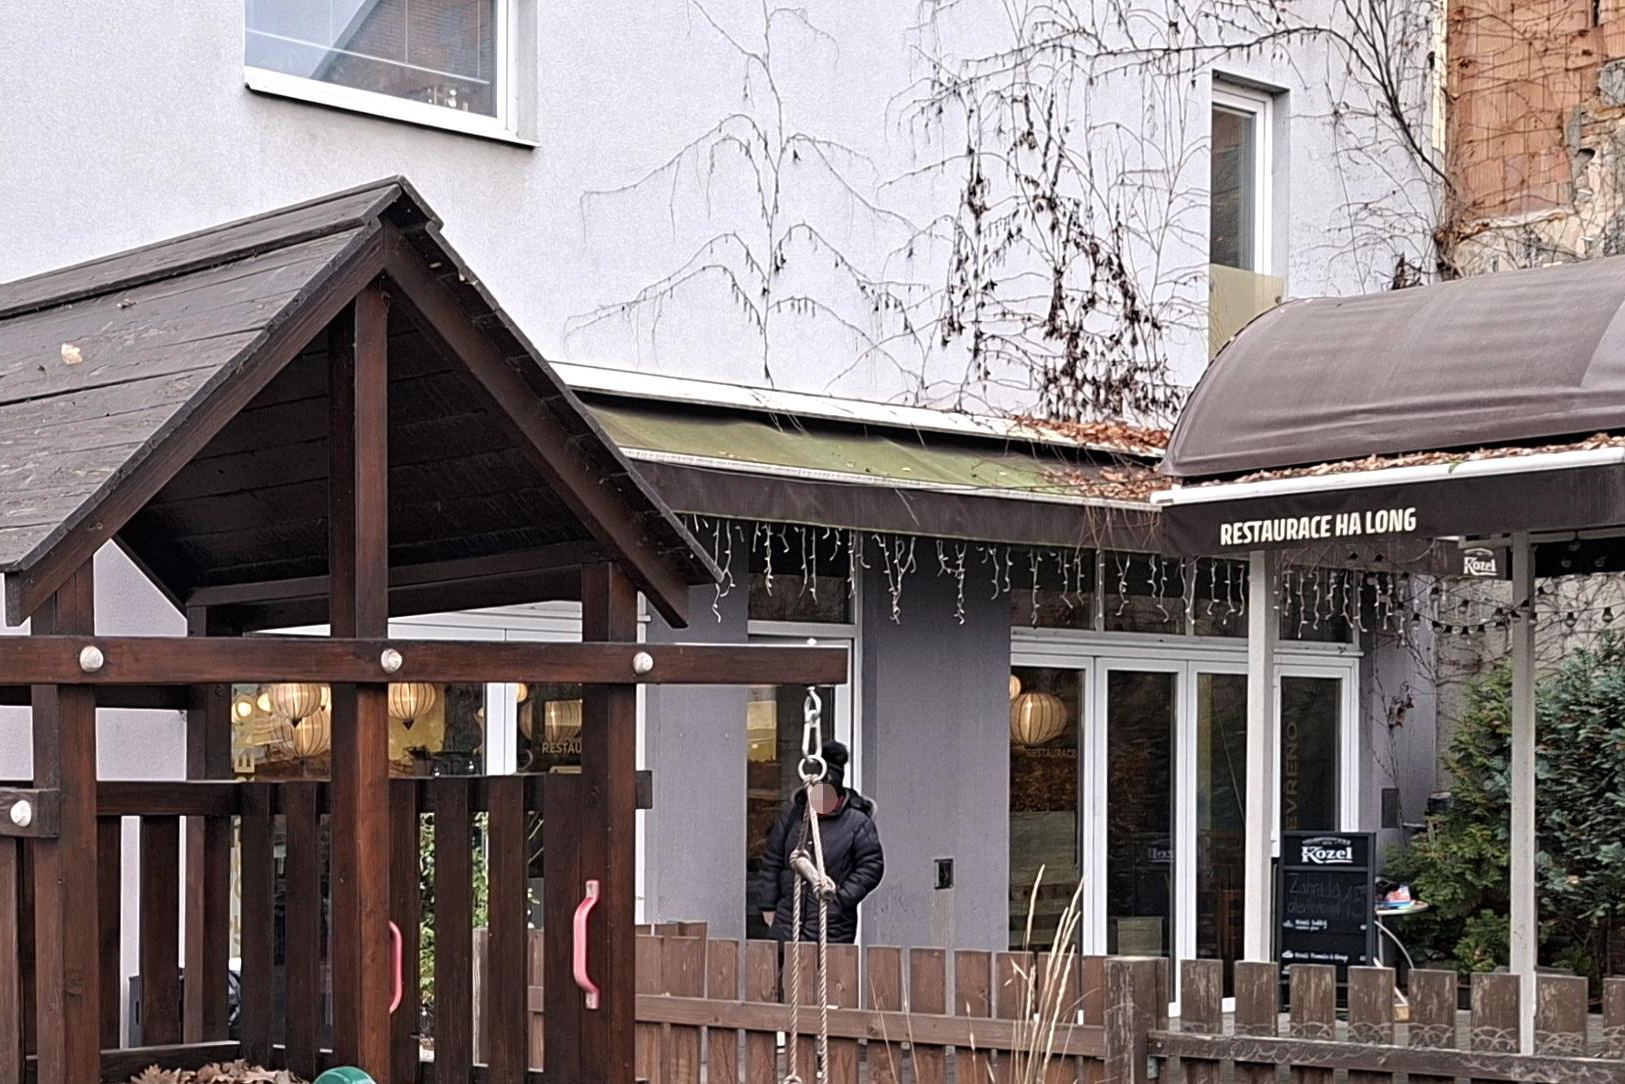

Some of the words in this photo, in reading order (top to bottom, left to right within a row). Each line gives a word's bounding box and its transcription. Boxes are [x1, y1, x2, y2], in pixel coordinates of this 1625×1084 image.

[1220, 515, 1332, 545] RESTAURACE
[1335, 512, 1361, 536] HA
[1365, 507, 1416, 534] LONG
[1463, 556, 1497, 576] Kozel
[542, 742, 582, 754] RESTAU
[1301, 846, 1353, 864] Kozel
